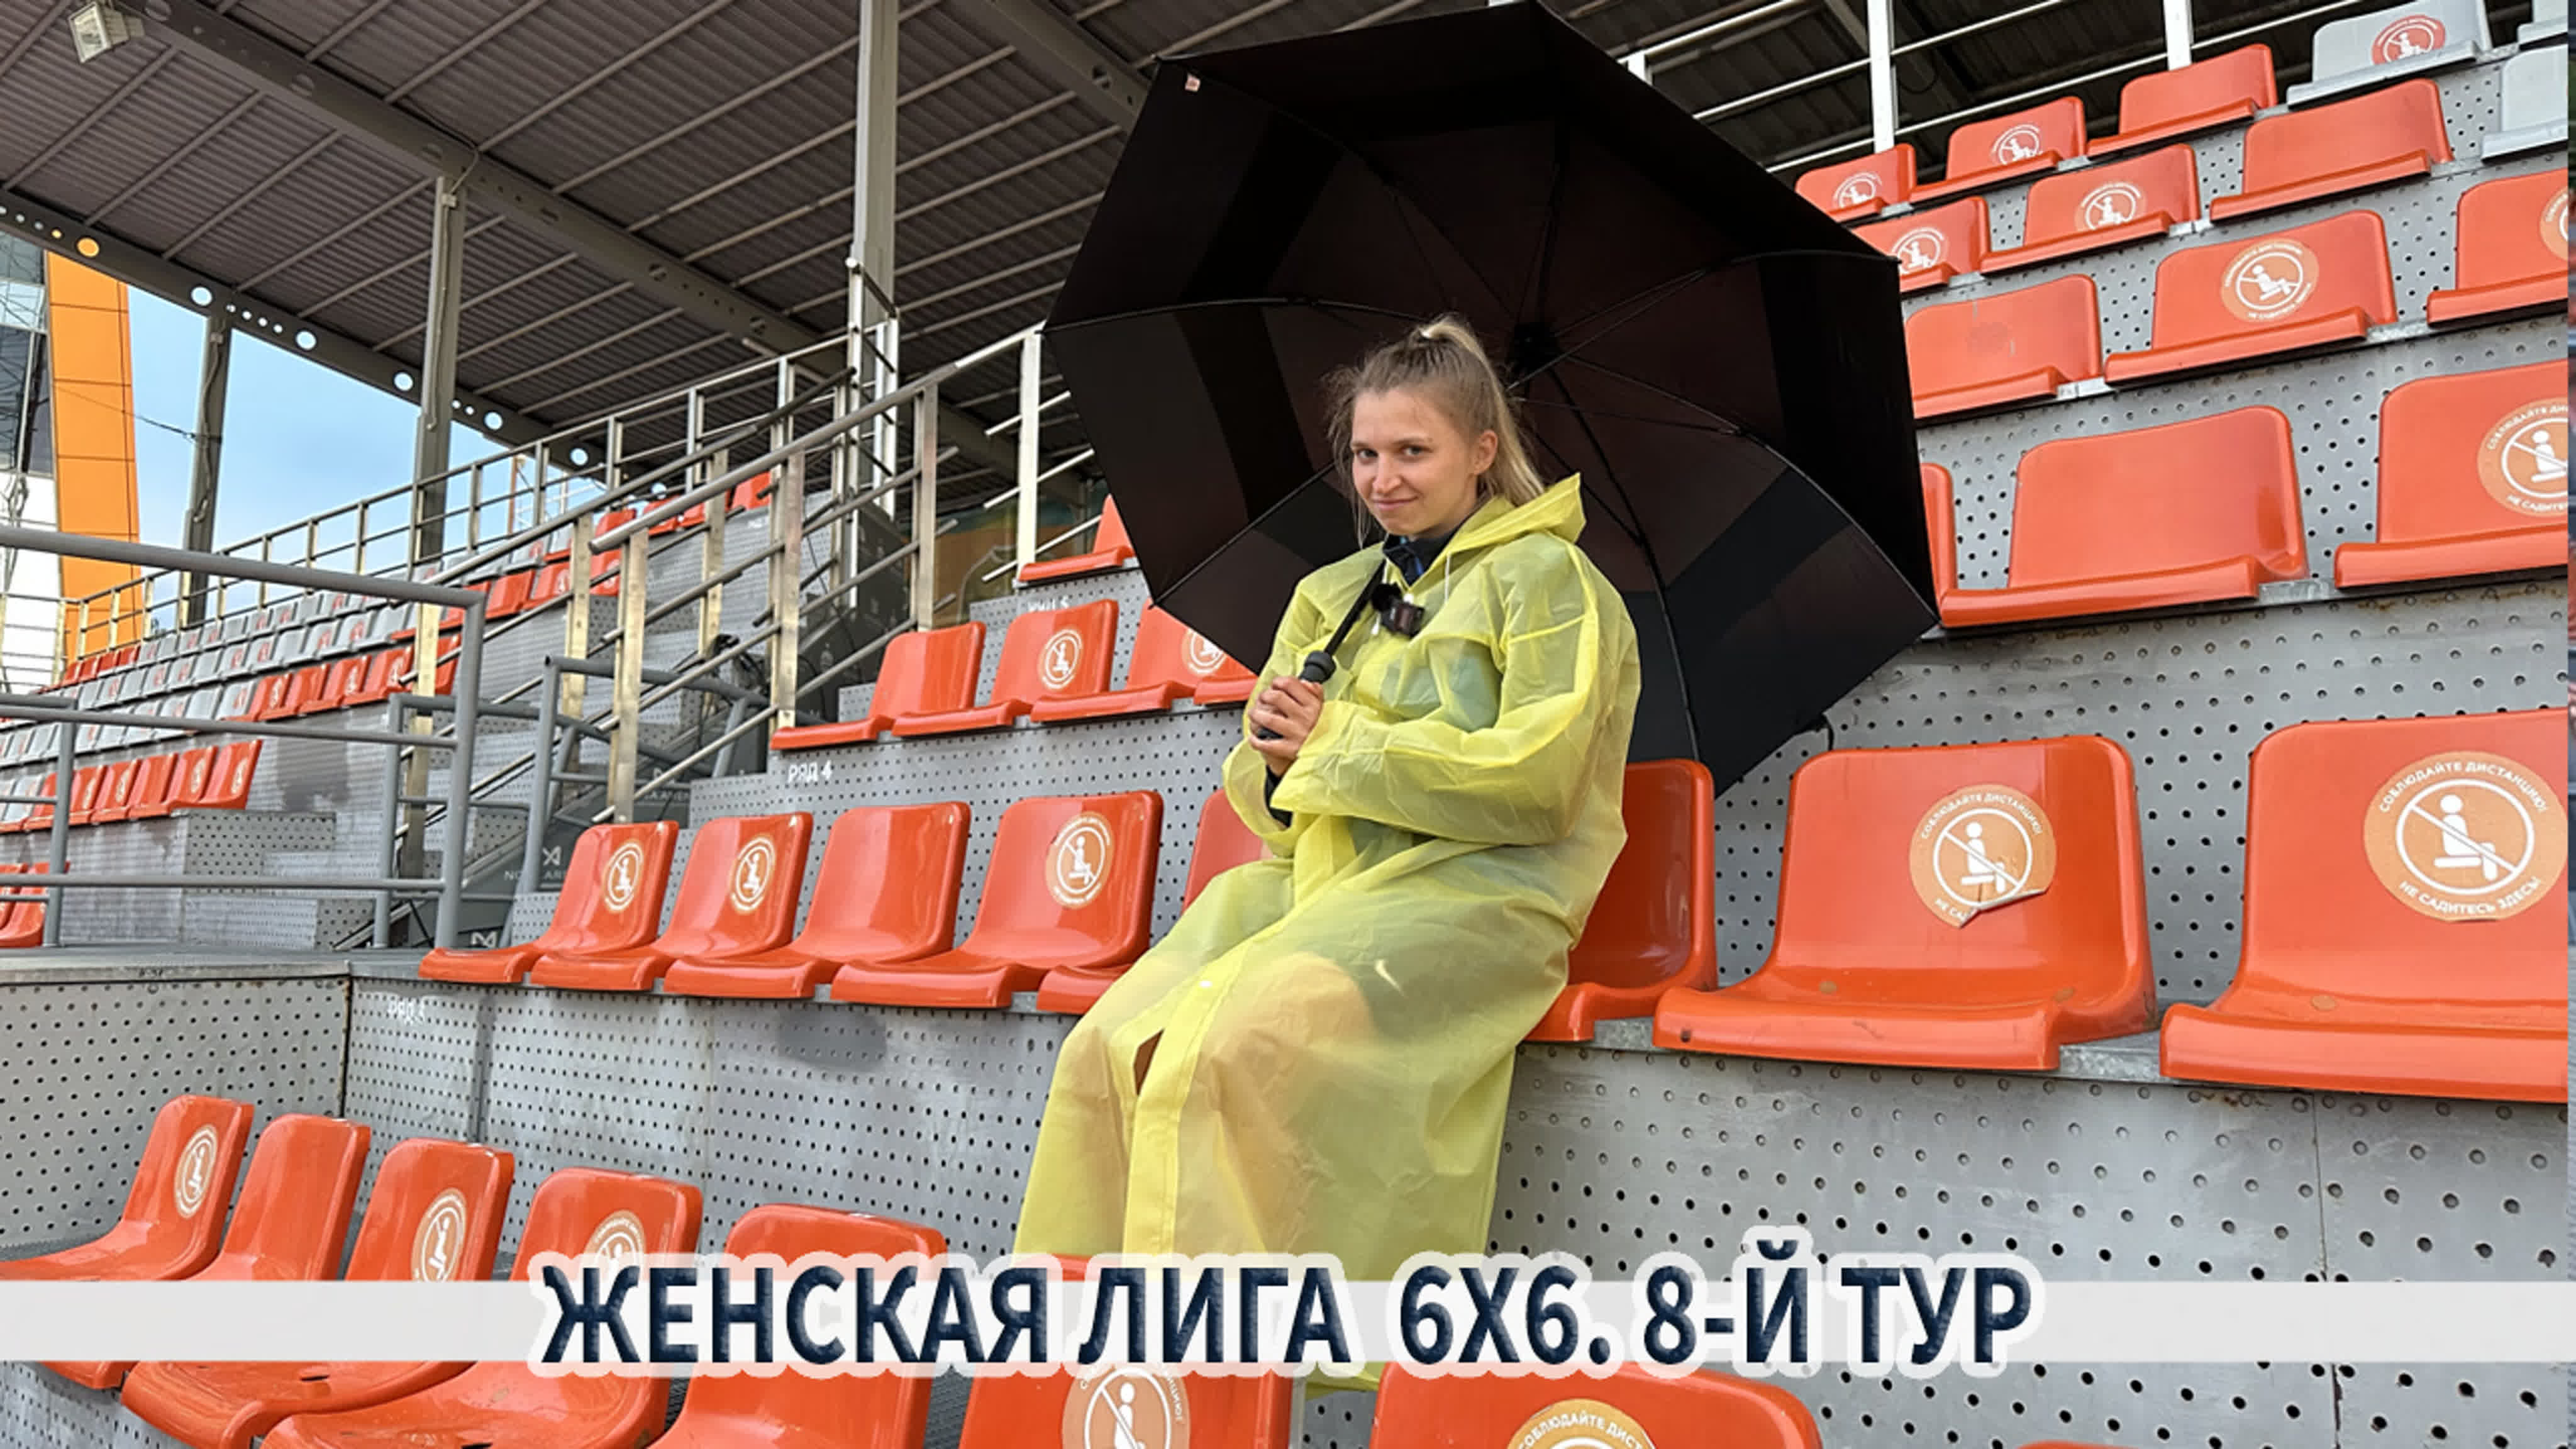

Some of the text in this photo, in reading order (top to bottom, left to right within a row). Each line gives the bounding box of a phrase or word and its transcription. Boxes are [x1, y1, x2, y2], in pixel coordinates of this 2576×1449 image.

[821, 759, 833, 780] 4
[2379, 761, 2462, 813] СОБЛЮДАЙТЕ
[2399, 880, 2418, 898] НЕ
[2419, 894, 2496, 914] САДИТЕСЬ
